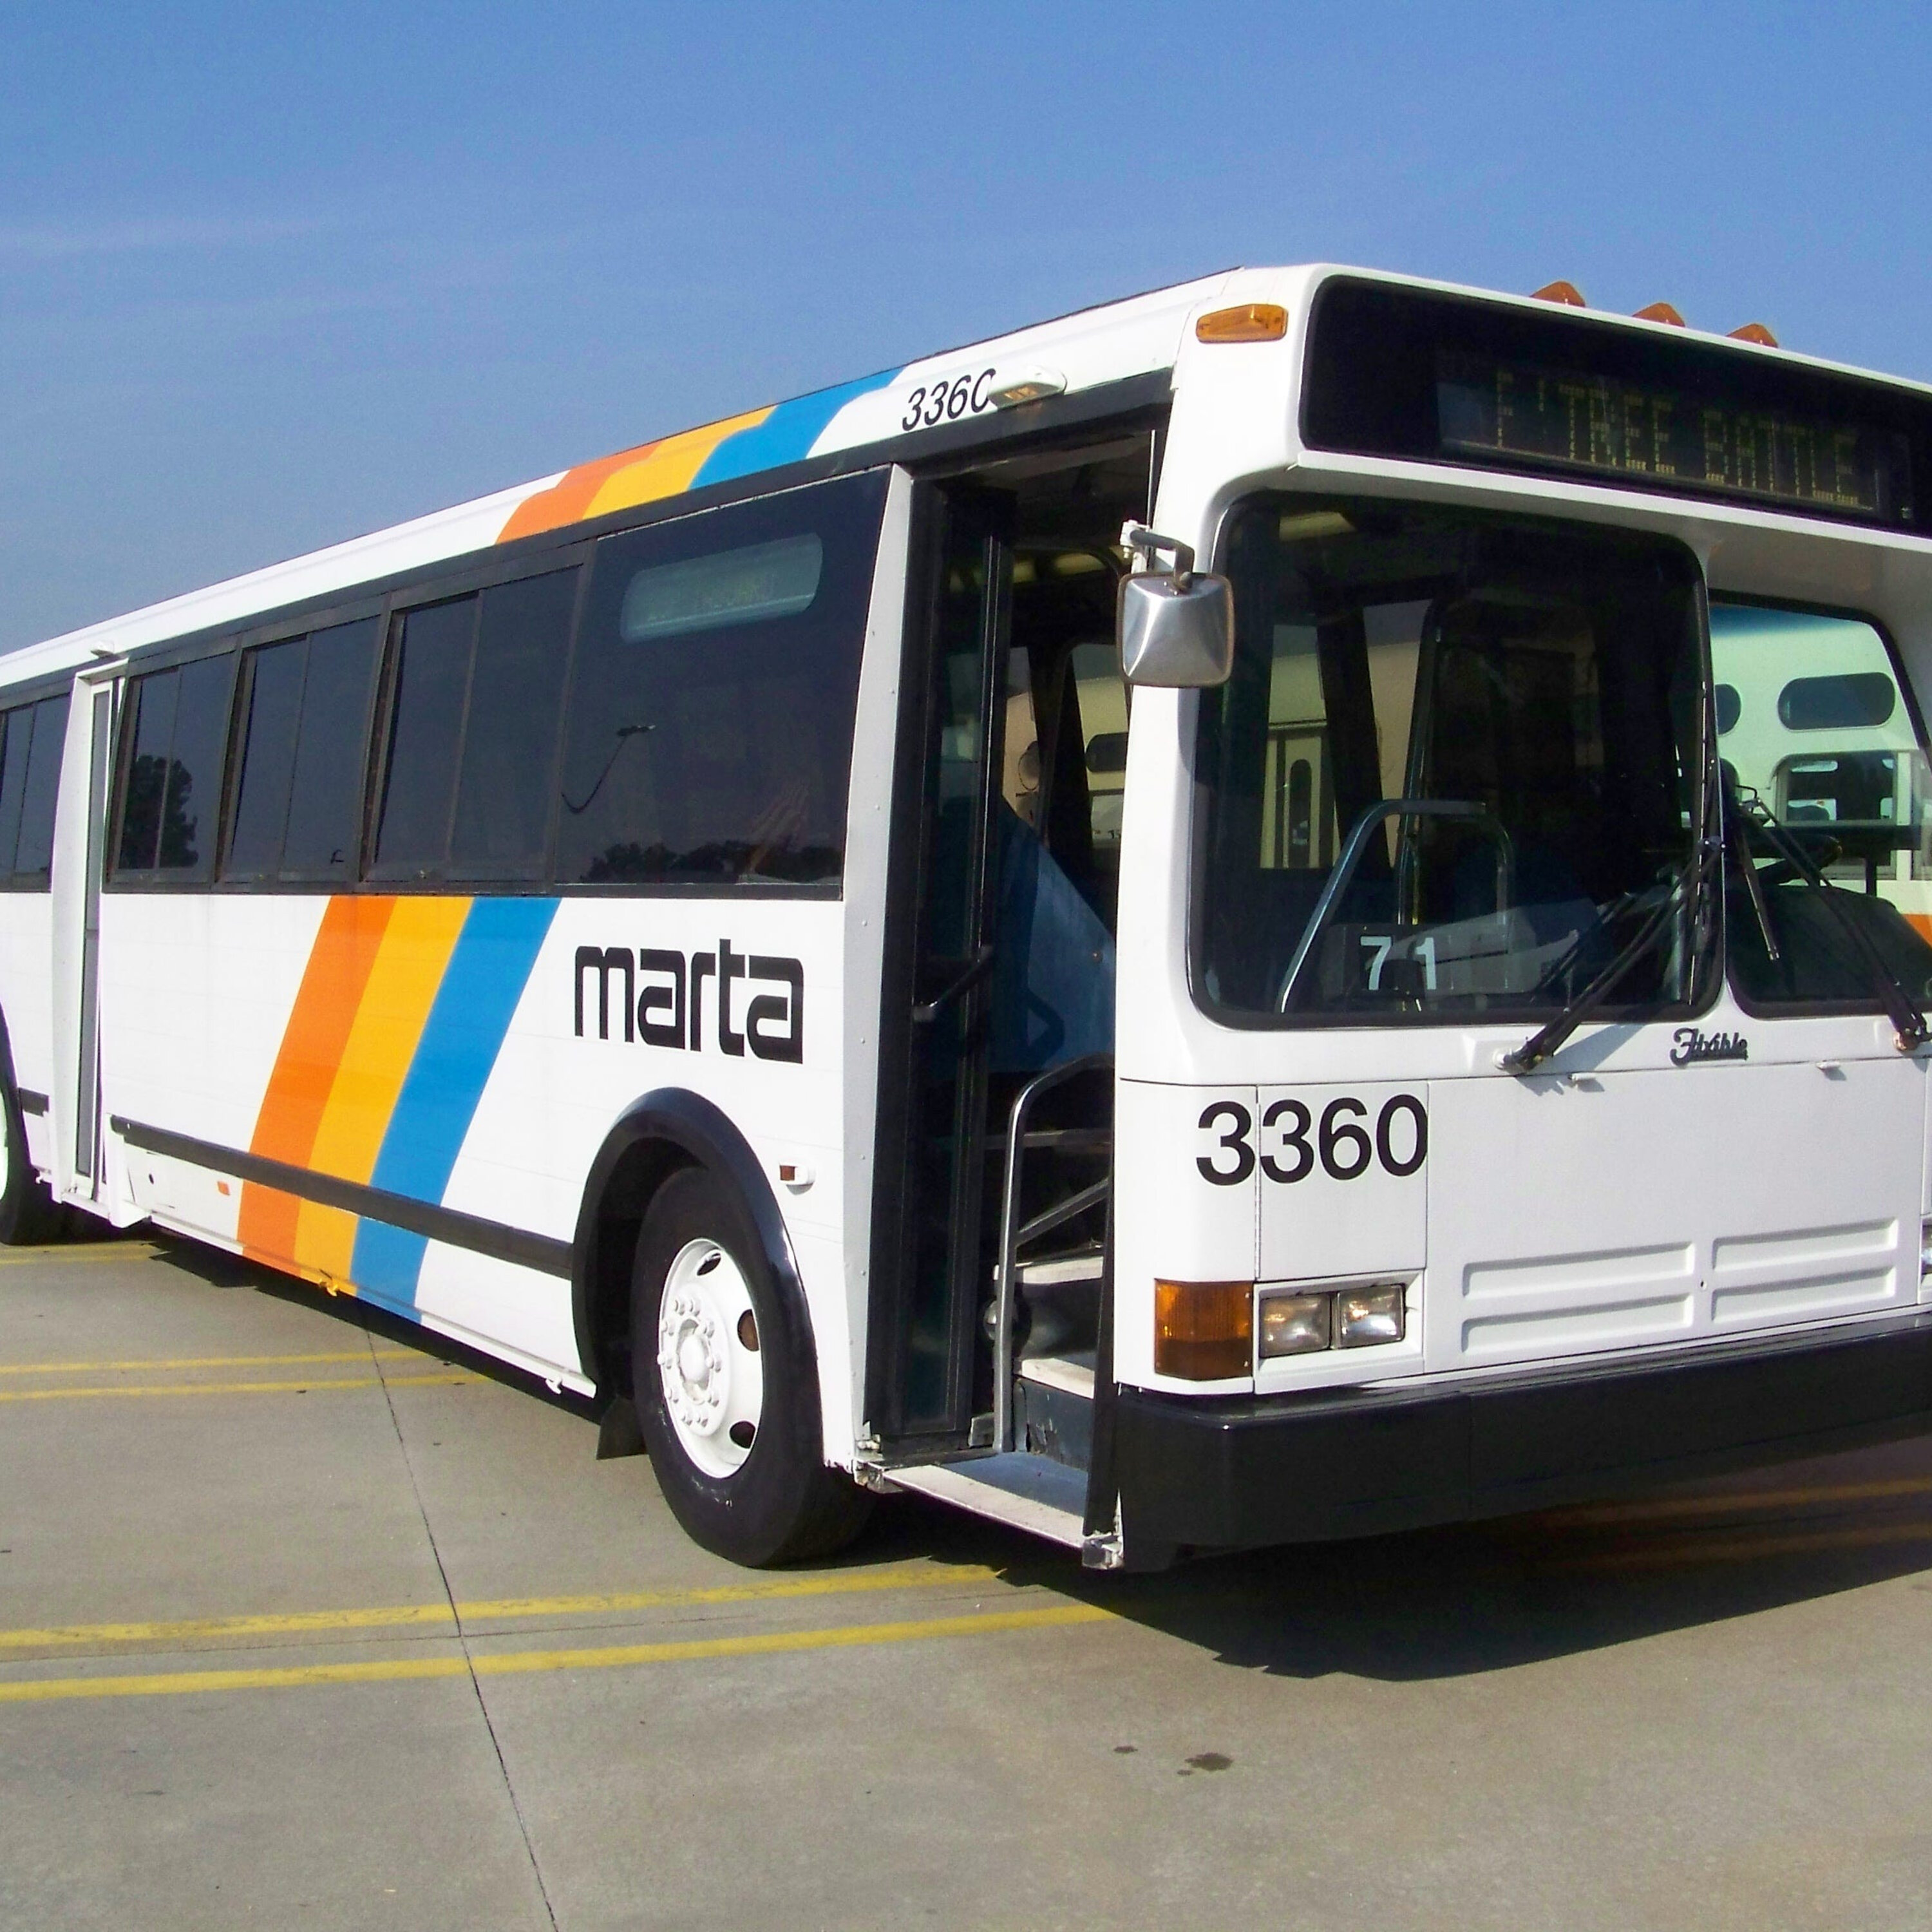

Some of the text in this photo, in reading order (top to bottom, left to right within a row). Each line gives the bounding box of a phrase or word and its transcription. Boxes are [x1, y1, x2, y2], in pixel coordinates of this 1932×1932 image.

[902, 368, 996, 431] 3360
[1703, 409, 1859, 506] BATTLE
[574, 938, 804, 1065] marta
[1360, 936, 1437, 990] 71
[1196, 1094, 1428, 1186] 3360
